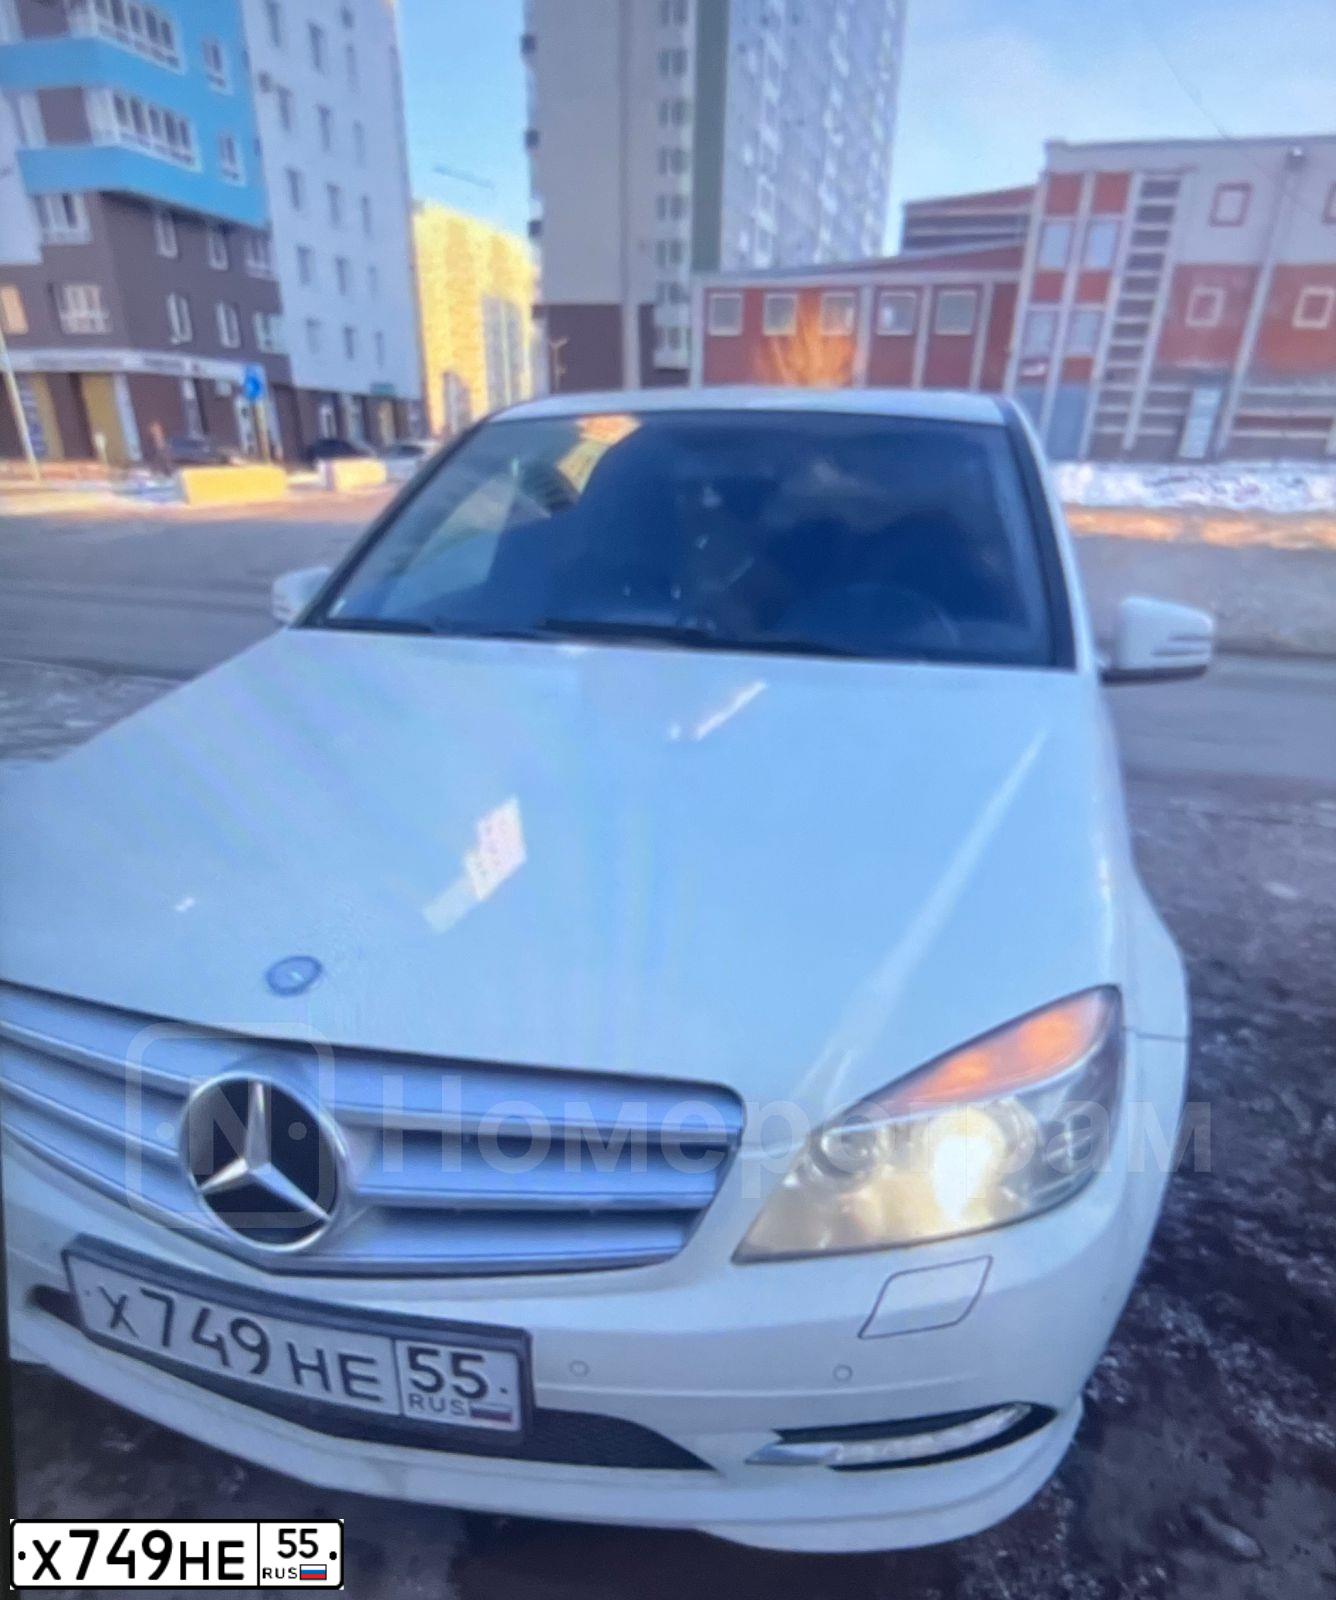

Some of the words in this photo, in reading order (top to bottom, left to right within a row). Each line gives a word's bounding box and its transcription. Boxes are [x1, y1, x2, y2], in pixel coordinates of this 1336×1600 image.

[97, 1284, 383, 1402] Х749НЕ
[406, 1346, 489, 1400] 55
[407, 1393, 467, 1417] RUS
